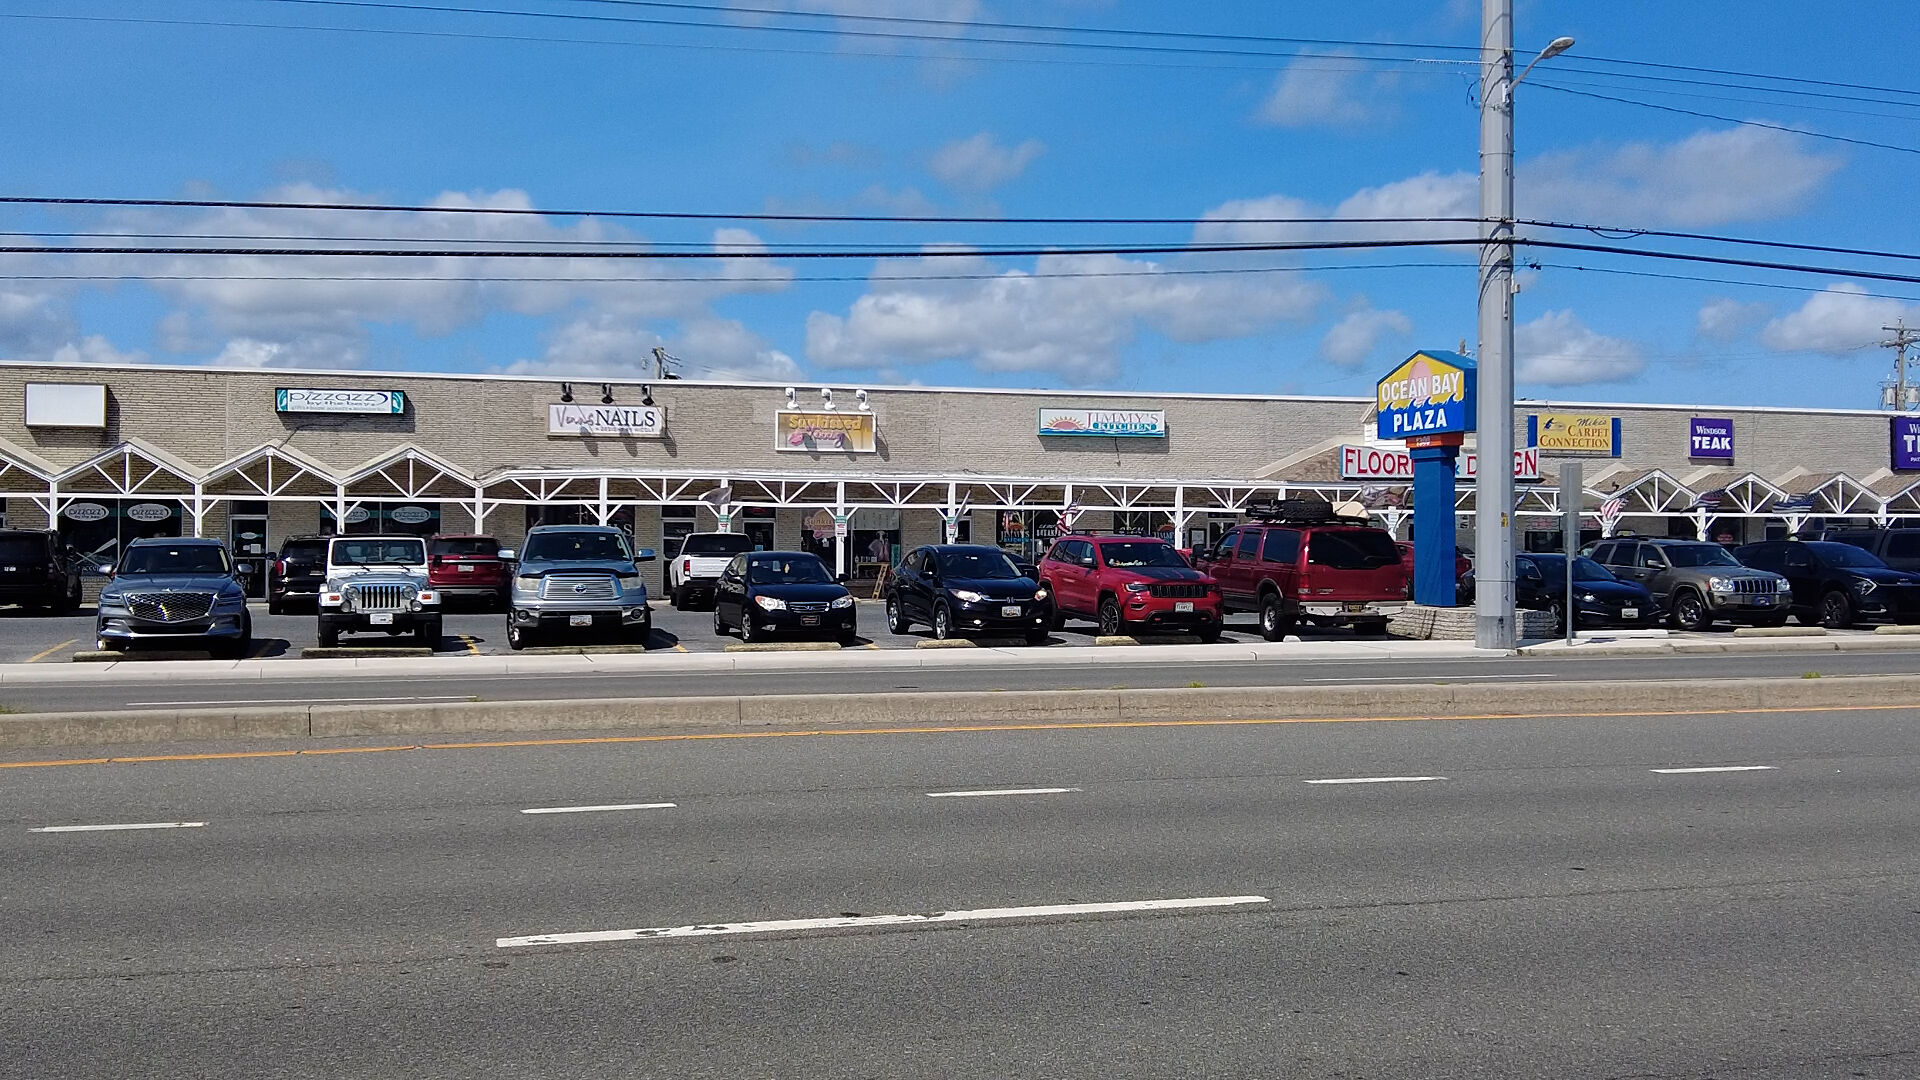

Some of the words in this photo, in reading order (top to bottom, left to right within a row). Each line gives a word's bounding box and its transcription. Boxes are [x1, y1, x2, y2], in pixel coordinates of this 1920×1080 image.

[1381, 377, 1428, 403] OCEAN
[1432, 371, 1461, 395] BAY
[595, 409, 655, 427] NAILS
[1086, 411, 1159, 428] JIMMY'S
[1100, 422, 1152, 431] KITCHEN
[1393, 408, 1448, 433] PLAZA
[1540, 435, 1609, 448] CONNECTION
[1692, 436, 1731, 449] TEAK
